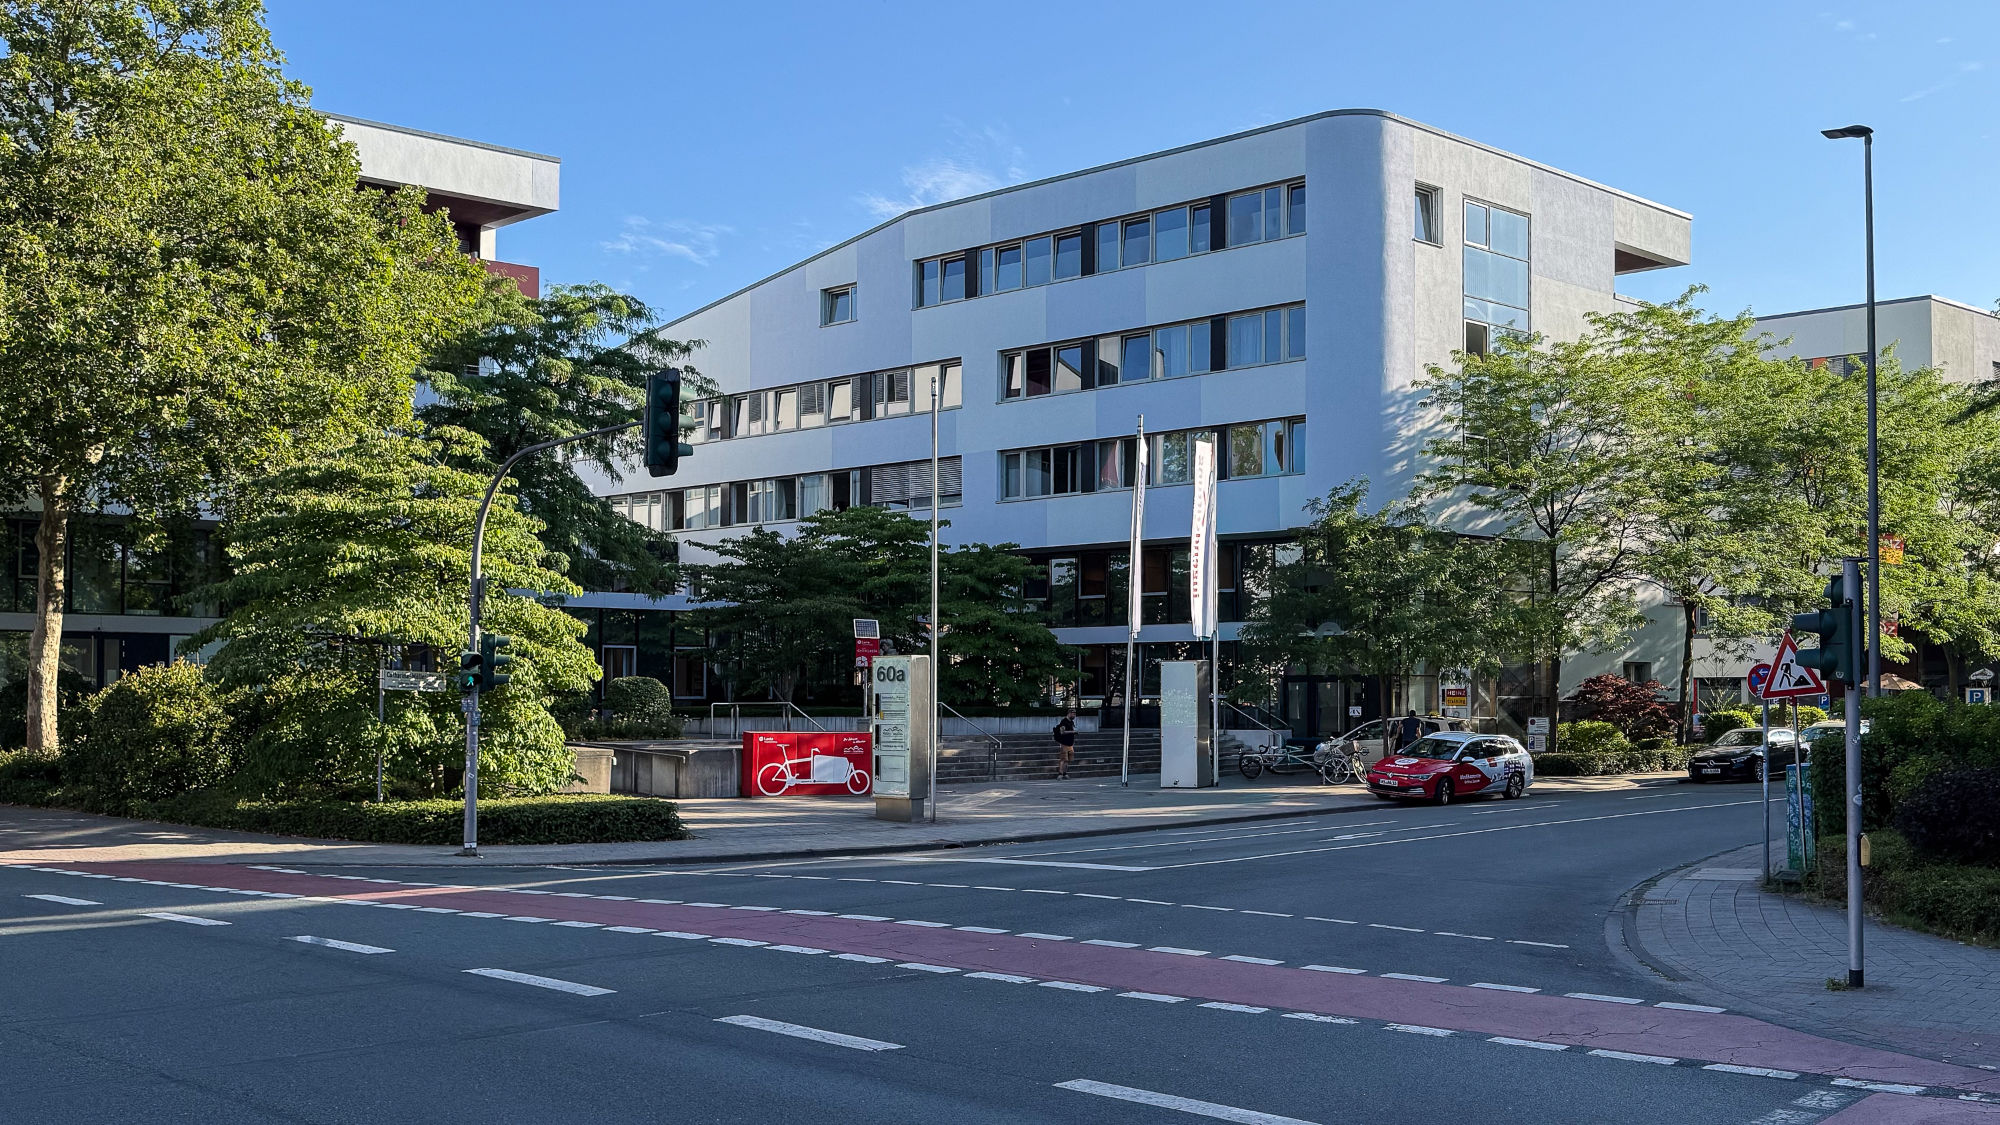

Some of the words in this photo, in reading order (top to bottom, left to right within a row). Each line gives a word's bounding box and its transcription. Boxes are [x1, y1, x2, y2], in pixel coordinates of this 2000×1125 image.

[877, 666, 905, 681] 60a
[1821, 695, 1828, 704] P
[1973, 692, 1982, 702] P
